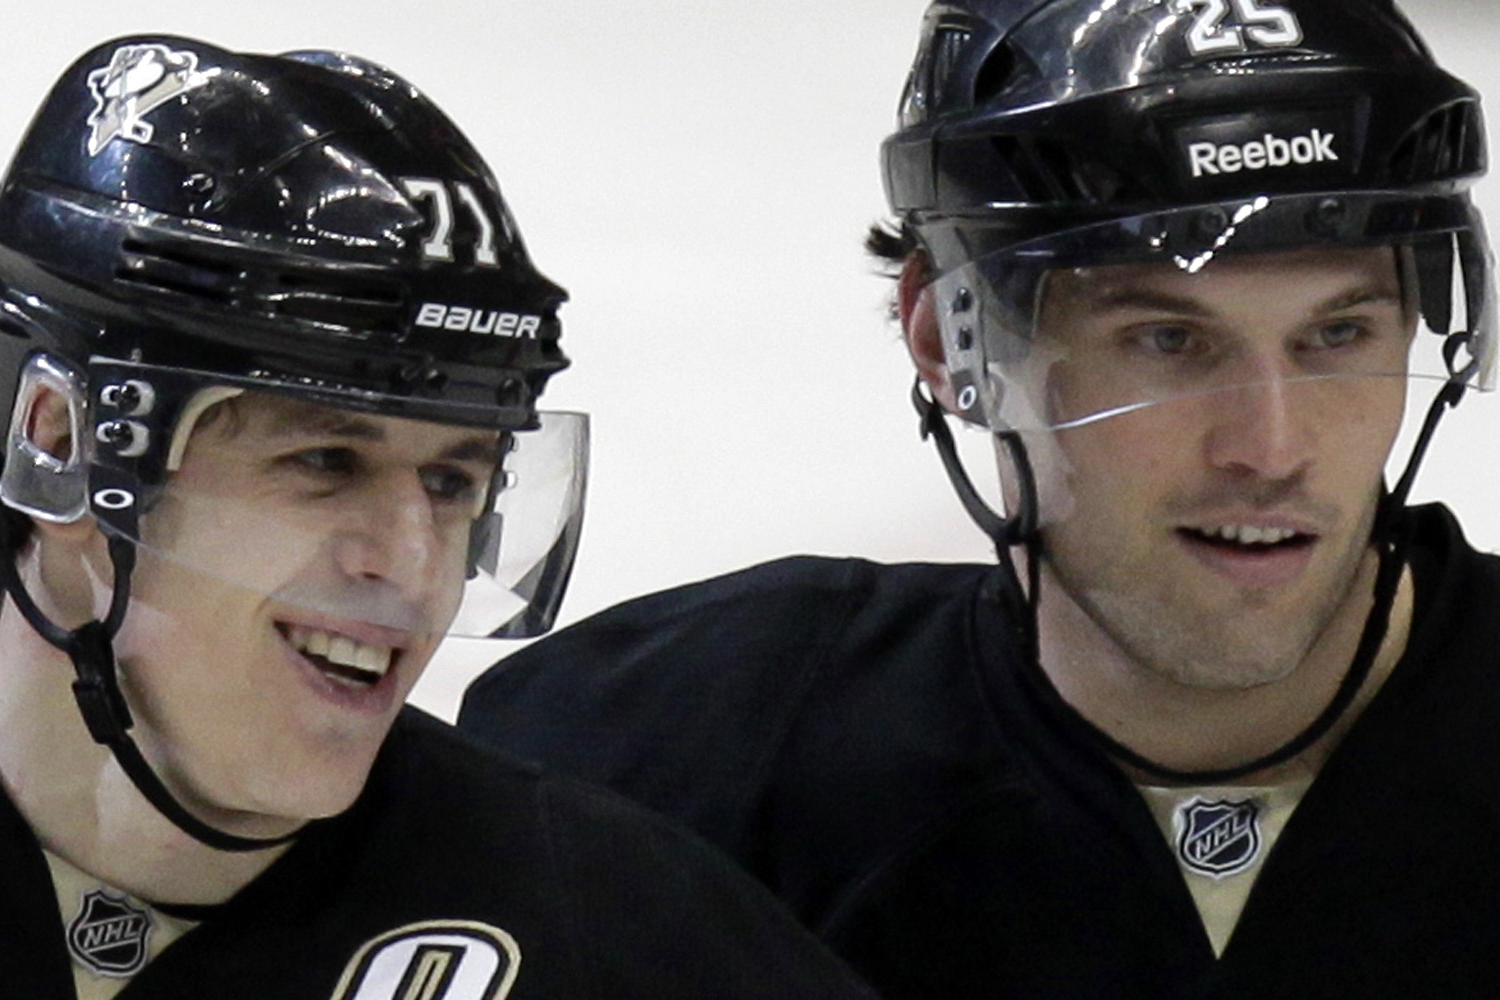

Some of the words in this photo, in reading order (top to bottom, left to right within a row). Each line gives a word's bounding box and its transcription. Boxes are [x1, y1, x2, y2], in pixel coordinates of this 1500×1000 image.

[1184, 0, 1304, 56] 25
[1188, 128, 1339, 178] Reebok
[399, 175, 500, 268] 71
[414, 303, 541, 340] BAUER
[1195, 815, 1248, 860] NHL
[82, 919, 138, 949] NHL
